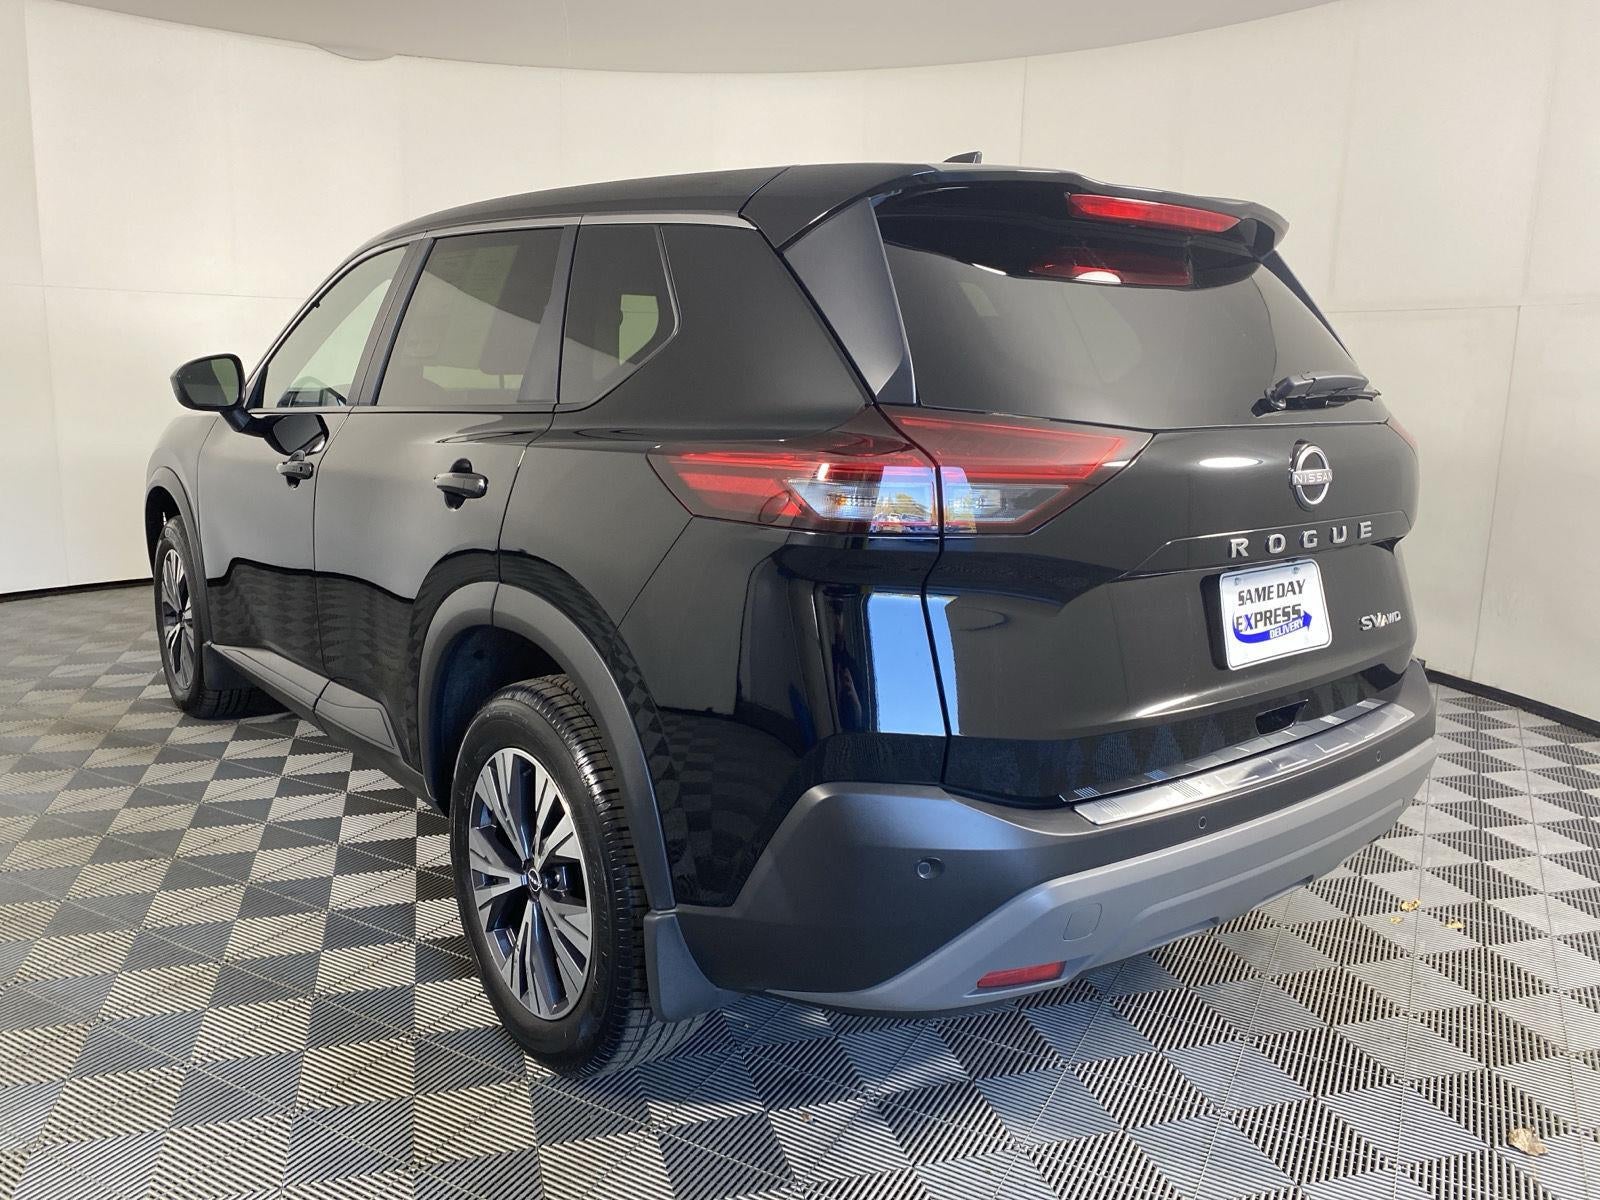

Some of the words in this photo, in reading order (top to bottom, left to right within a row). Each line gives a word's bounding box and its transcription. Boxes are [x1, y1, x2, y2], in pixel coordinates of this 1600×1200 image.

[1294, 472, 1333, 484] NISSAN
[1229, 520, 1373, 558] ROGUE
[1238, 584, 1274, 607] SAME
[1276, 578, 1306, 599] DAY
[1235, 603, 1302, 632] EXPRESS
[1270, 619, 1304, 640] DELIVERY
[1360, 612, 1382, 630] SV
[1380, 610, 1402, 627] AWD
